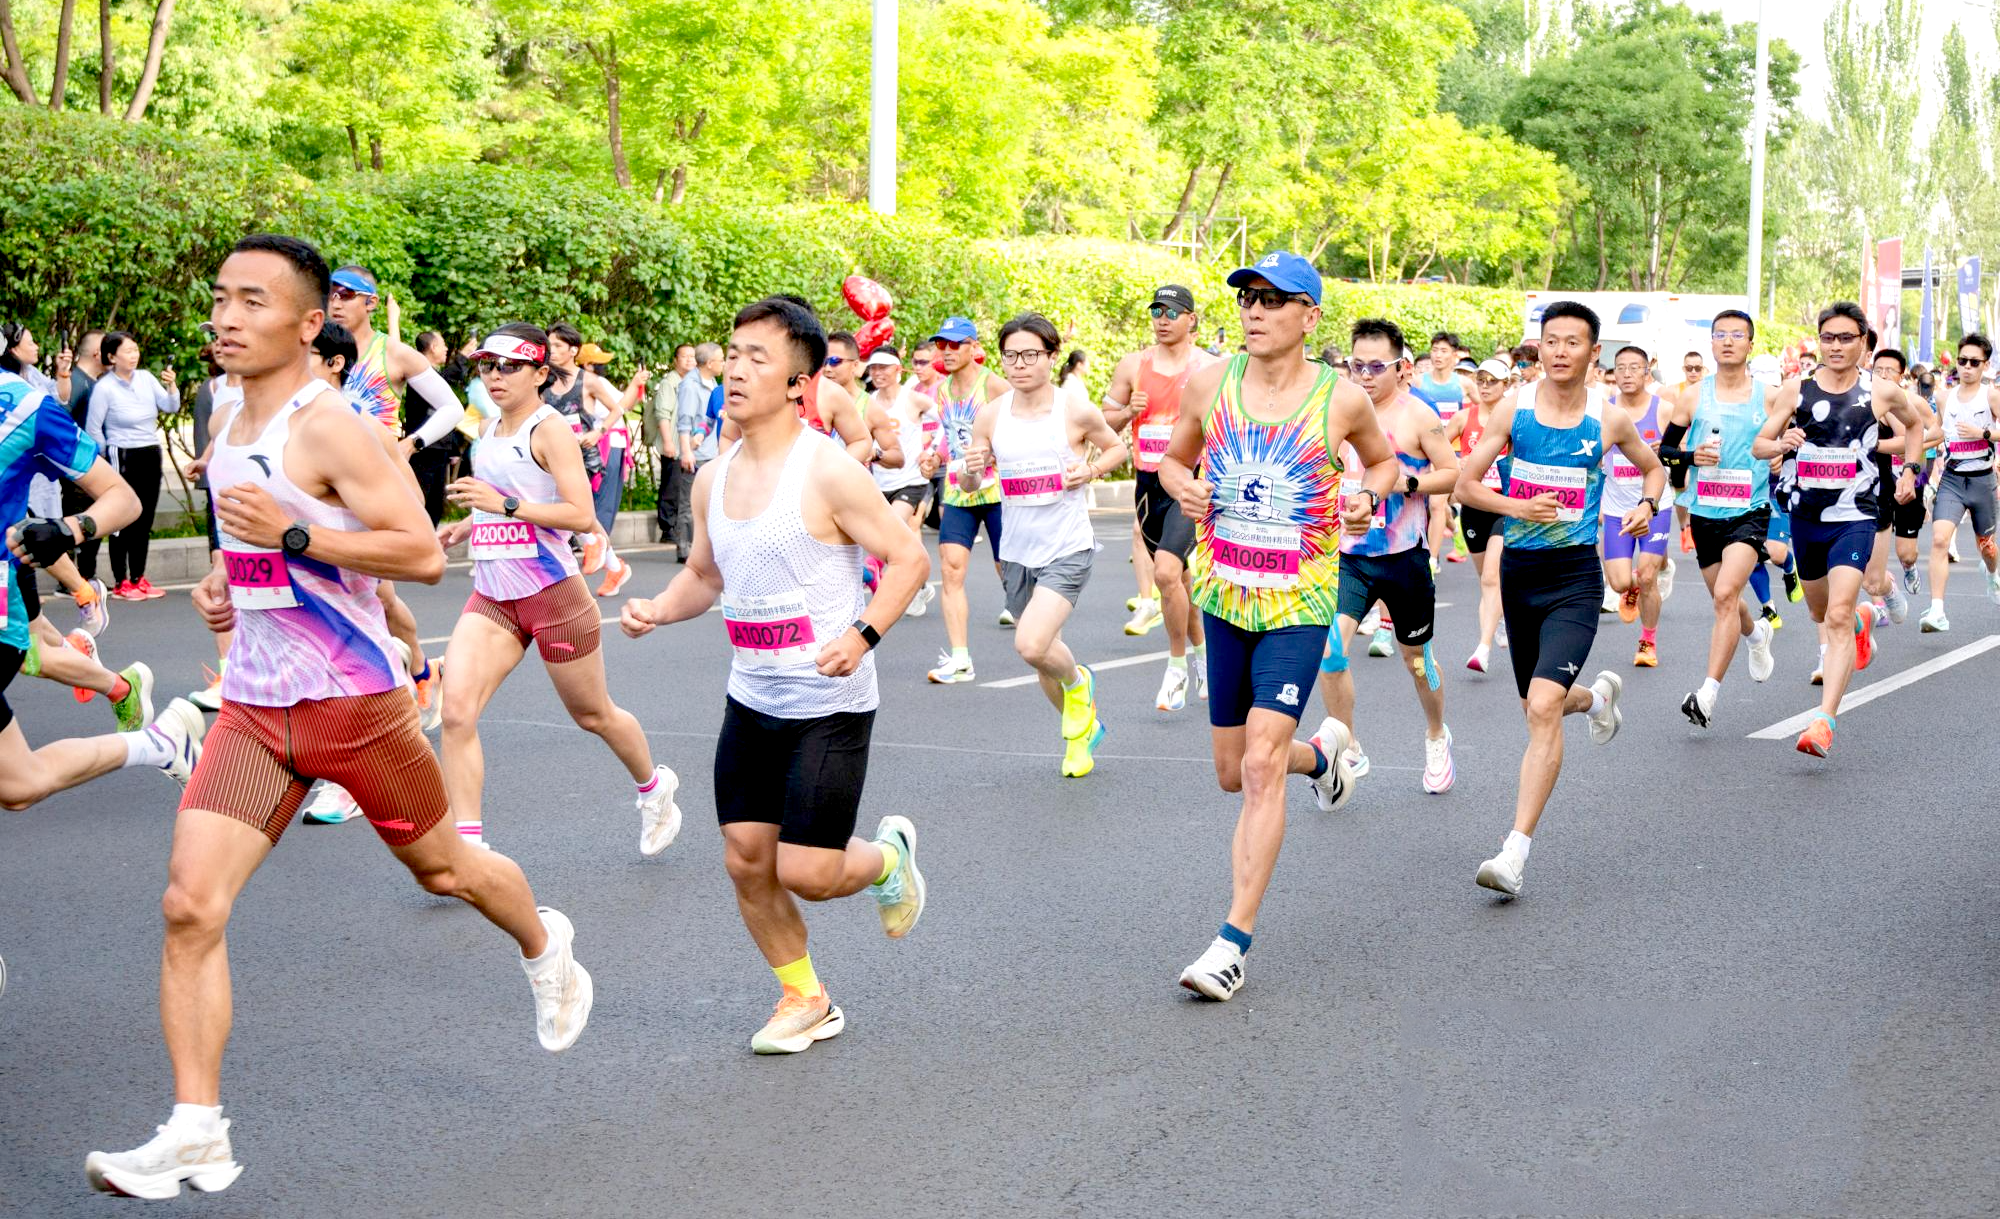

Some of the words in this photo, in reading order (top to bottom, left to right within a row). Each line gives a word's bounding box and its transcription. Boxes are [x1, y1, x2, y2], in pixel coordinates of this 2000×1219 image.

[1804, 465, 1850, 477] A10016
[1008, 476, 1056, 493] A10974
[1703, 484, 1745, 497] A10973
[473, 525, 530, 544] A20004
[1220, 544, 1288, 571] A10051
[734, 622, 803, 647] A10072
